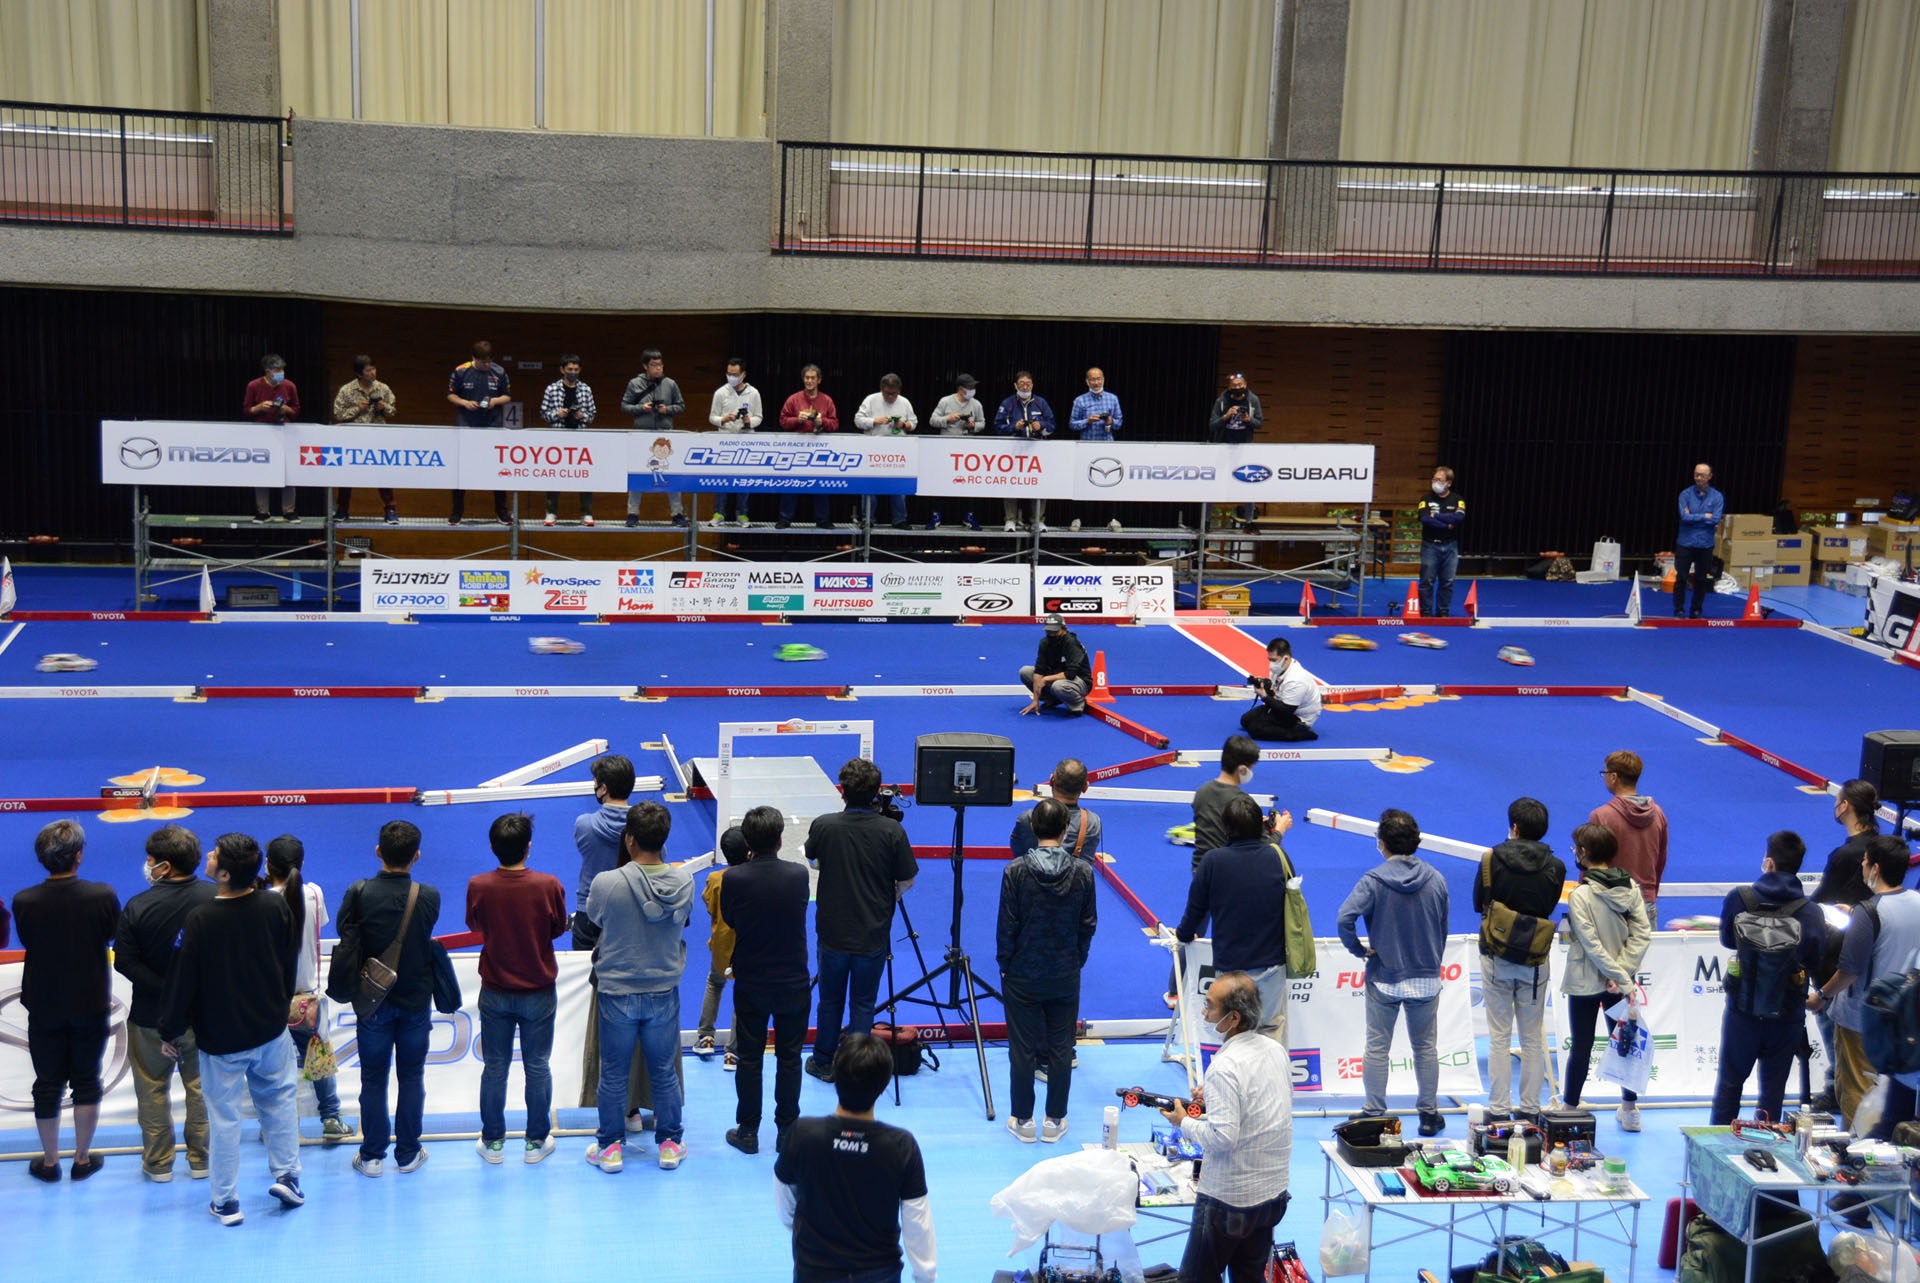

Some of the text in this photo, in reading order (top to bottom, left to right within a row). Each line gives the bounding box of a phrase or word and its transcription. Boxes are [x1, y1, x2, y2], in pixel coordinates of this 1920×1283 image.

[505, 405, 520, 426] 4
[168, 445, 271, 464] mazda
[345, 448, 446, 467] TAMIYA
[494, 445, 593, 466] TOYOTA
[868, 454, 906, 463] TOYOTA
[950, 453, 1042, 473] TOYOTA
[514, 468, 589, 478] RC CAR CLUB
[1128, 464, 1216, 481] mazda
[1278, 467, 1369, 480] SUBARU
[732, 478, 816, 488] トヨタチャレンジカップ
[968, 475, 1038, 485] RC CAR CLUB
[372, 569, 451, 585] ラジコンマガジン
[461, 571, 507, 583] TamTam
[670, 577, 700, 588] GR
[748, 572, 804, 583] MAEDA
[973, 577, 1020, 586] SHINKO
[1063, 576, 1102, 585] WORK
[377, 595, 446, 605] KO PROPO
[544, 590, 588, 610] ZEST
[813, 599, 873, 607] FUJITSUBO
[1060, 602, 1098, 610] CUSCO
[1407, 598, 1419, 610] 11
[1752, 601, 1759, 614] 1
[1096, 671, 1106, 686] 8
[60, 689, 99, 697] TOYOTA
[293, 688, 330, 697] TOYOTA
[515, 688, 549, 696] TOYOTA
[727, 688, 761, 696] TOYOTA
[1131, 687, 1163, 695] TOYOTA
[1105, 714, 1121, 728] TOYOTA
[1762, 752, 1780, 767] TOYOTA
[542, 761, 561, 774] TOYOTA
[1097, 767, 1120, 780] TOYOTA
[263, 795, 307, 804] TOYOTA
[833, 1138, 869, 1153] TOM'S
